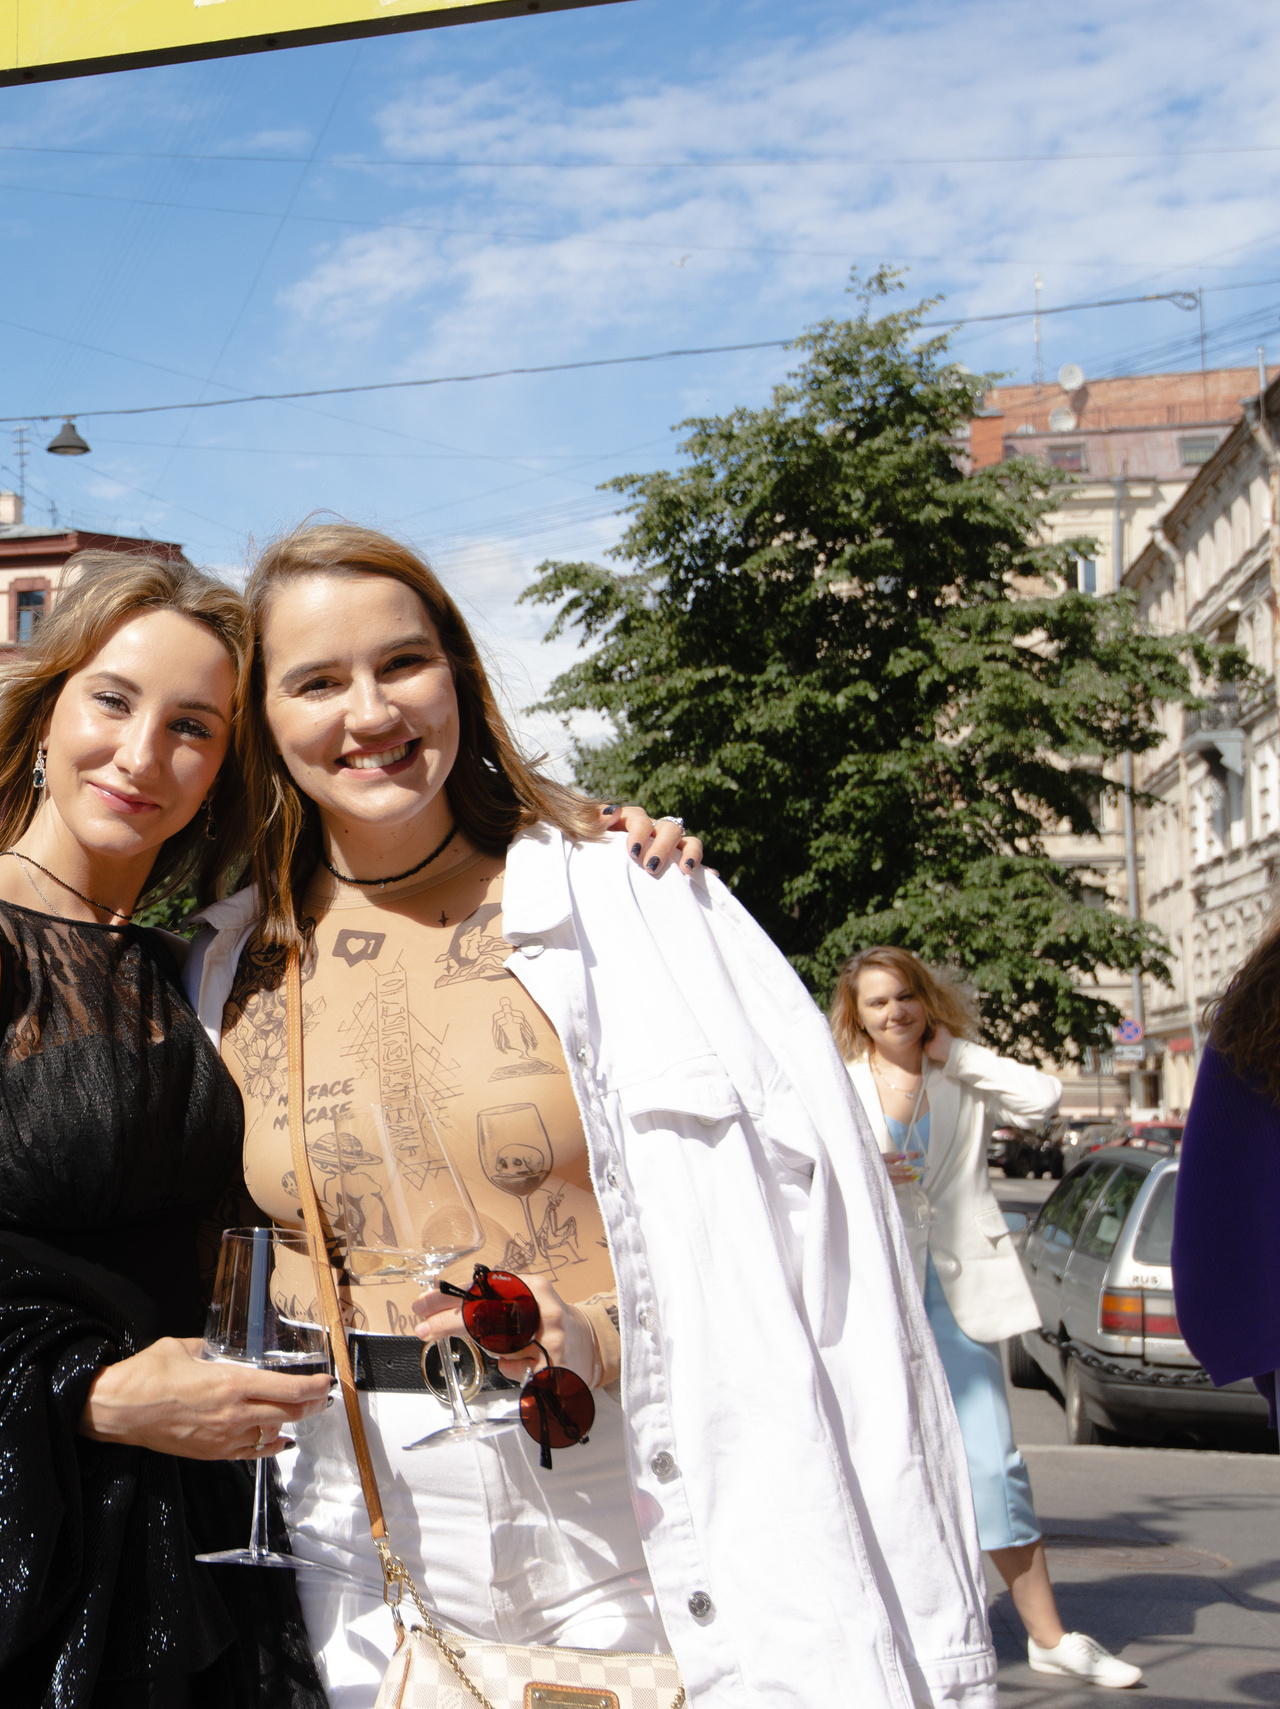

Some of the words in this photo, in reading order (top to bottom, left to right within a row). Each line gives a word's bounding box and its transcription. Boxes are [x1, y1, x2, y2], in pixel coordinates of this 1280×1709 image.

[307, 1077, 355, 1102] FACE
[305, 1101, 354, 1125] CASE
[1132, 1275, 1158, 1284] RUS
